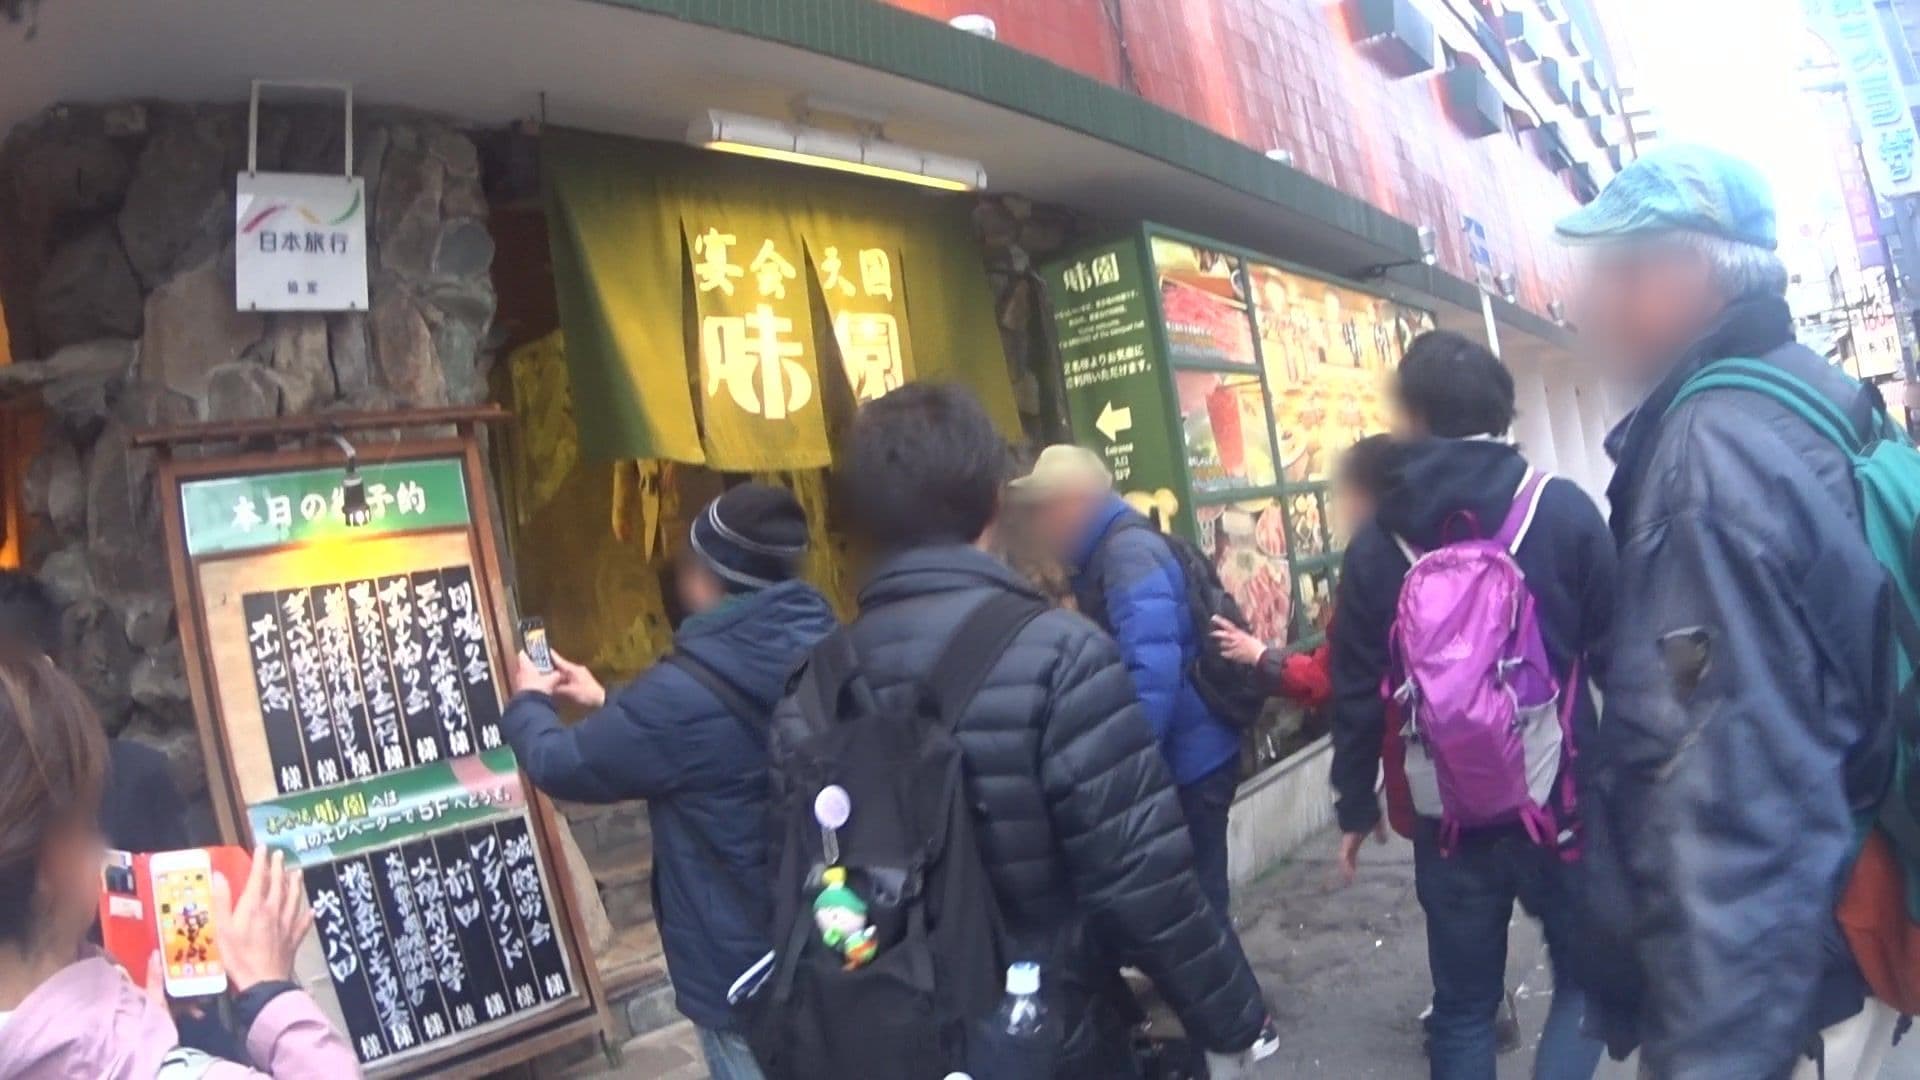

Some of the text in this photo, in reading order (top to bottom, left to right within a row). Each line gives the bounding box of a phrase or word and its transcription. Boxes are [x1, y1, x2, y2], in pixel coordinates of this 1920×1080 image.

[259, 230, 348, 254] 日本旅行
[703, 304, 904, 419] 味園
[444, 858, 480, 928] 前田
